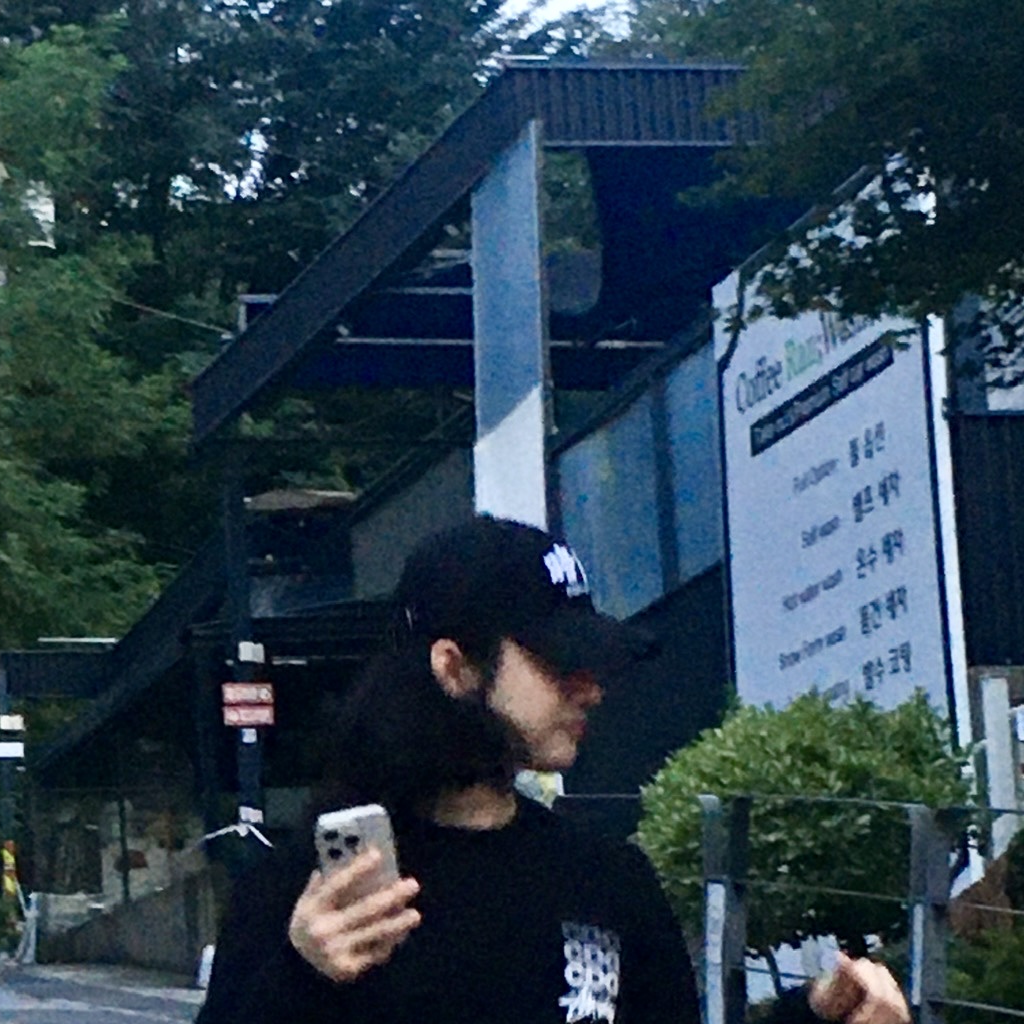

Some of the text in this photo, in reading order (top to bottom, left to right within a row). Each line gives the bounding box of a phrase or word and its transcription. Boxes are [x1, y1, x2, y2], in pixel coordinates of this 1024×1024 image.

[852, 469, 901, 523] 셀프 세차
[856, 528, 904, 579] 온수 세차
[886, 585, 908, 620] 세차
[888, 640, 912, 674] 코팅
